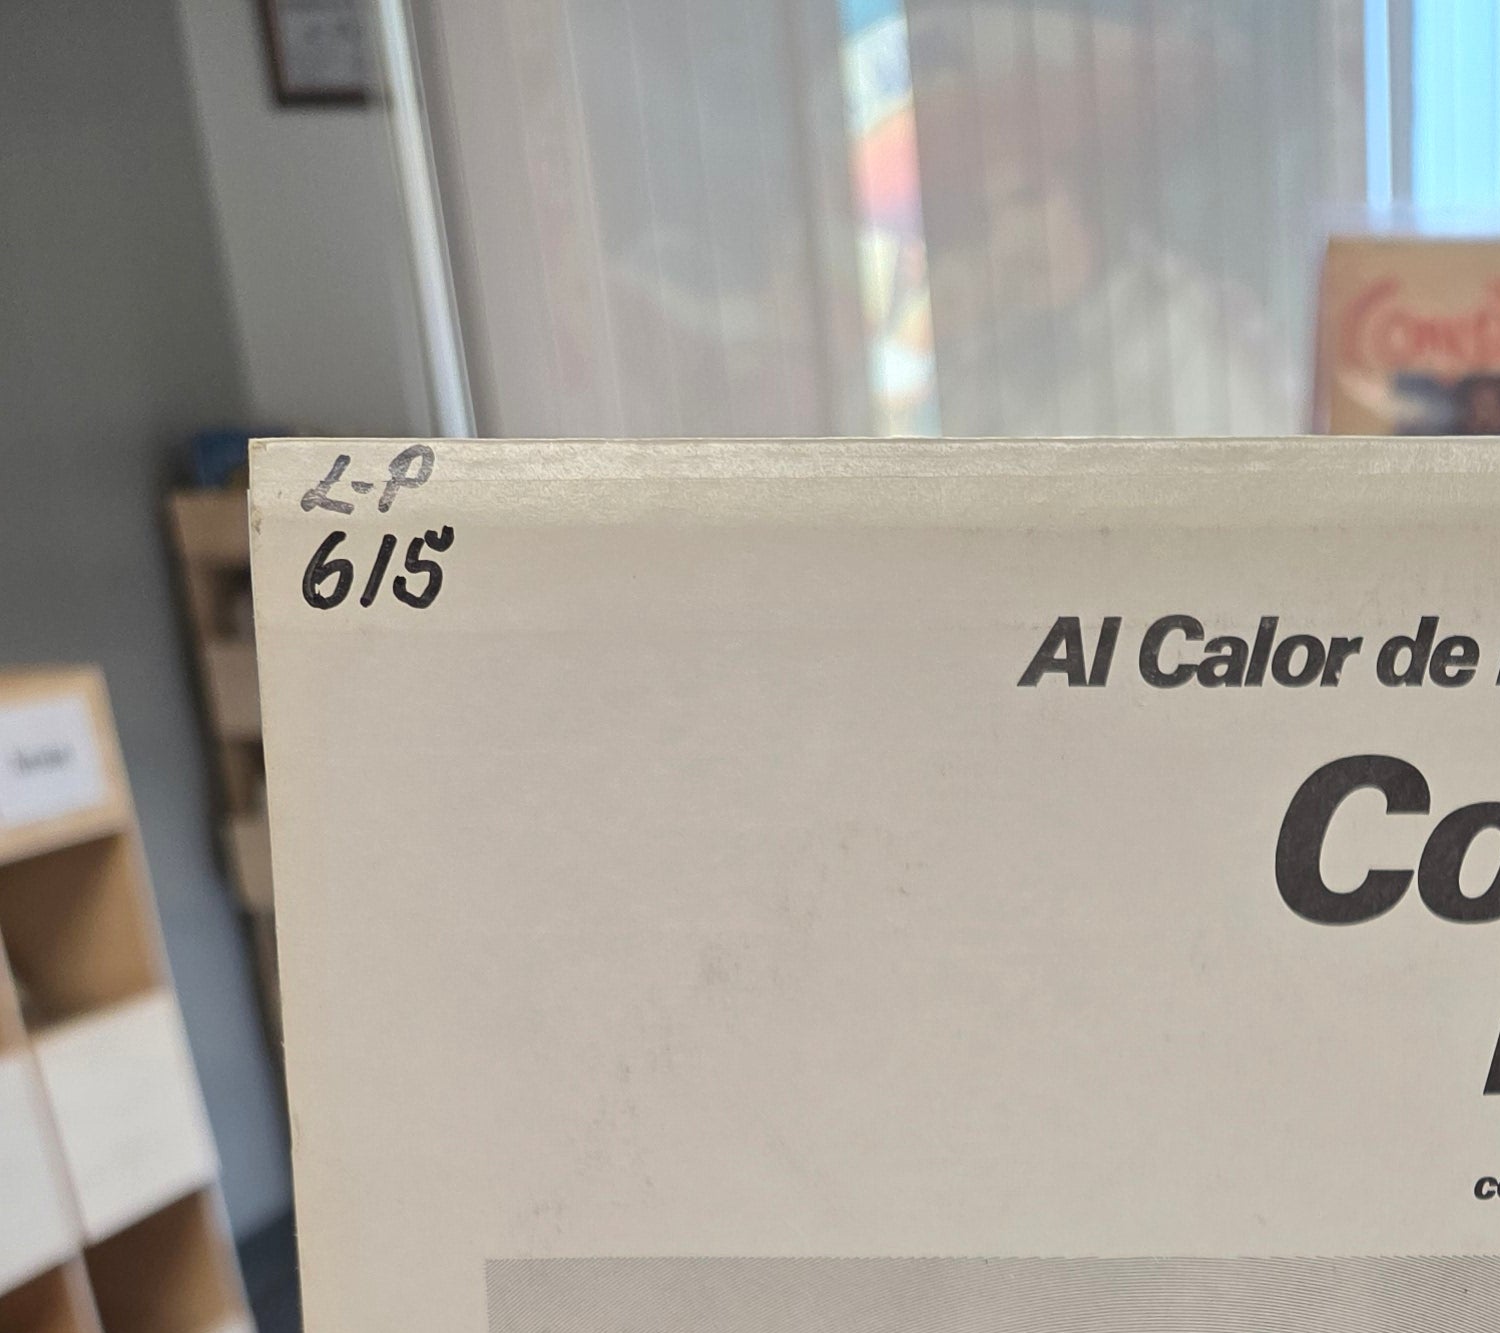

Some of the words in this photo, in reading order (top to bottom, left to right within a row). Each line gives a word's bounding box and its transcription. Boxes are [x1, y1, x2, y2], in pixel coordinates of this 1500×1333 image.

[302, 524, 455, 611] 615
[1017, 616, 1122, 687] Al
[1138, 614, 1364, 688] Calor
[1376, 615, 1480, 687] de
